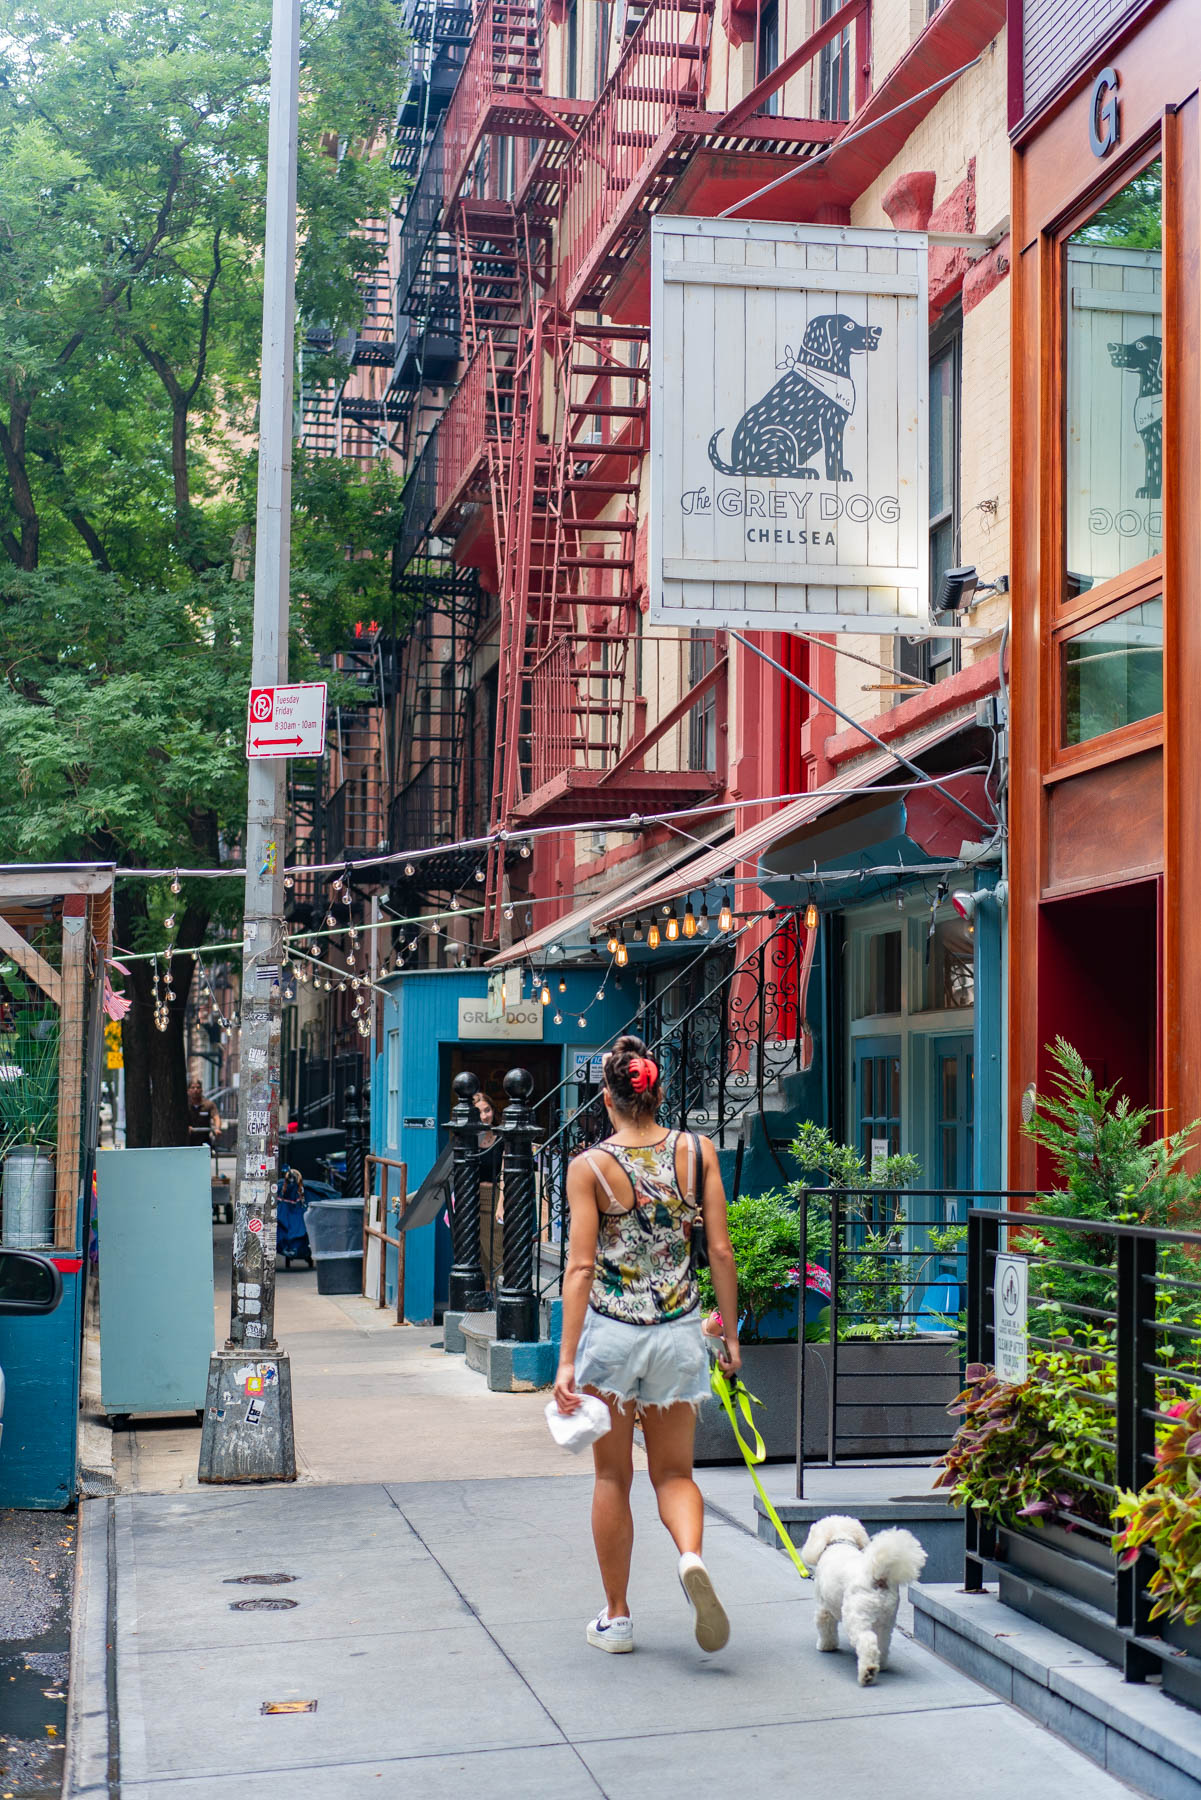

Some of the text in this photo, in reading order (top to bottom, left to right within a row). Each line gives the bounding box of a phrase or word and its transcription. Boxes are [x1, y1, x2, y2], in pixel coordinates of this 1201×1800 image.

[1089, 66, 1121, 158] G
[680, 486, 901, 524] The GREY DOG
[746, 528, 836, 546] CHELSEA
[276, 695, 299, 705] Tuesday
[275, 706, 293, 716] Friday
[274, 721, 296, 731] 8:30am
[301, 720, 317, 729] 10am
[506, 1011, 538, 1025] DOG
